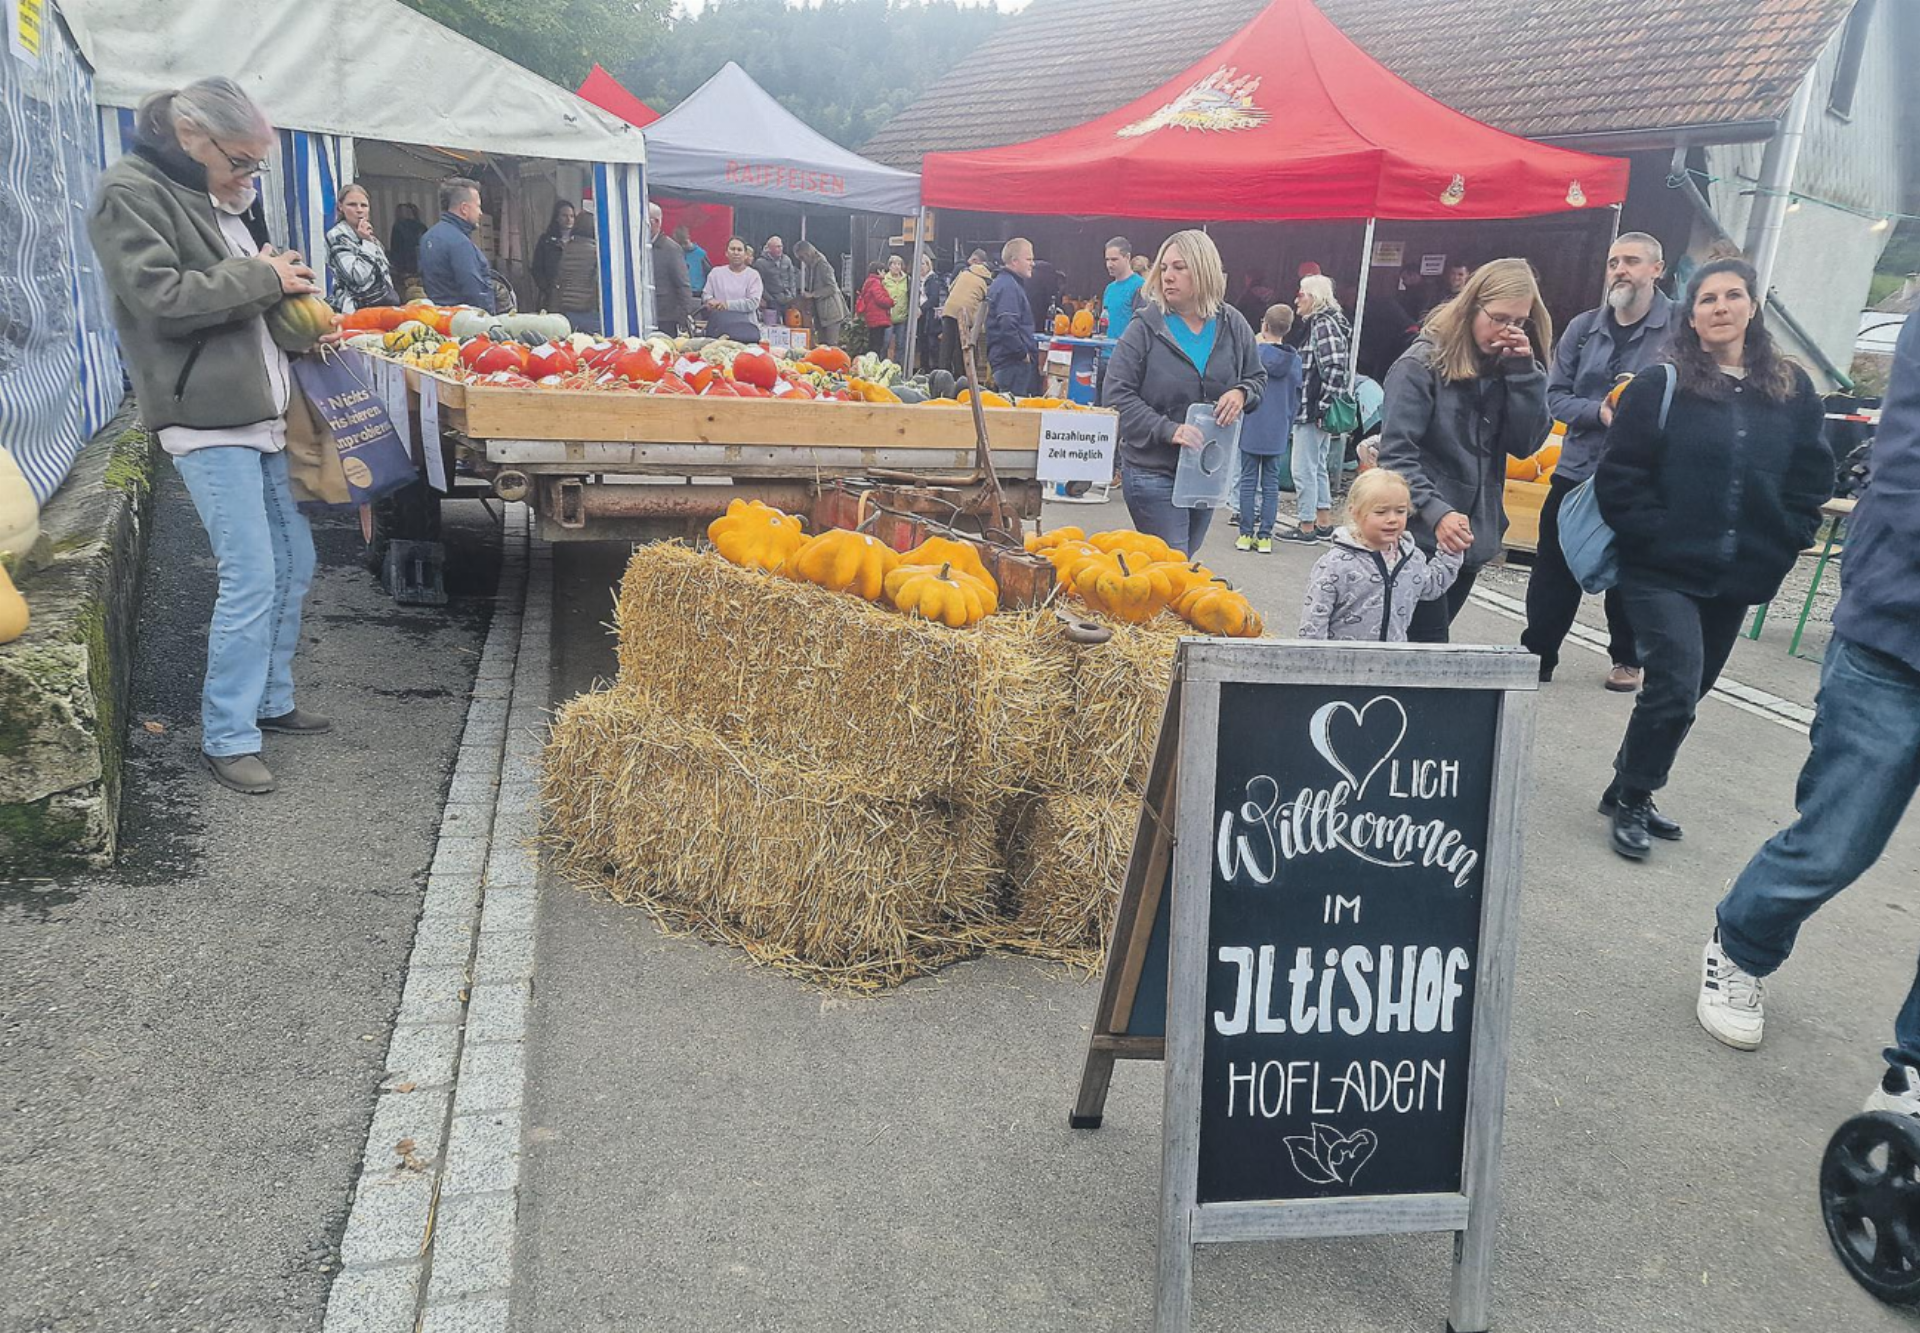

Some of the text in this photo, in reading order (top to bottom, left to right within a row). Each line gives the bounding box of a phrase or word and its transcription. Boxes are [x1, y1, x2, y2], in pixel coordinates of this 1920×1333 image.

[725, 160, 845, 194] RAIFFEISEN
[327, 390, 369, 410] Nichts
[1045, 429, 1109, 444] Barzahlung im
[1048, 448, 1103, 461] Zeit möglich
[1389, 759, 1459, 799] LICH
[1217, 775, 1479, 889] Willkommen
[1323, 894, 1361, 925] IM
